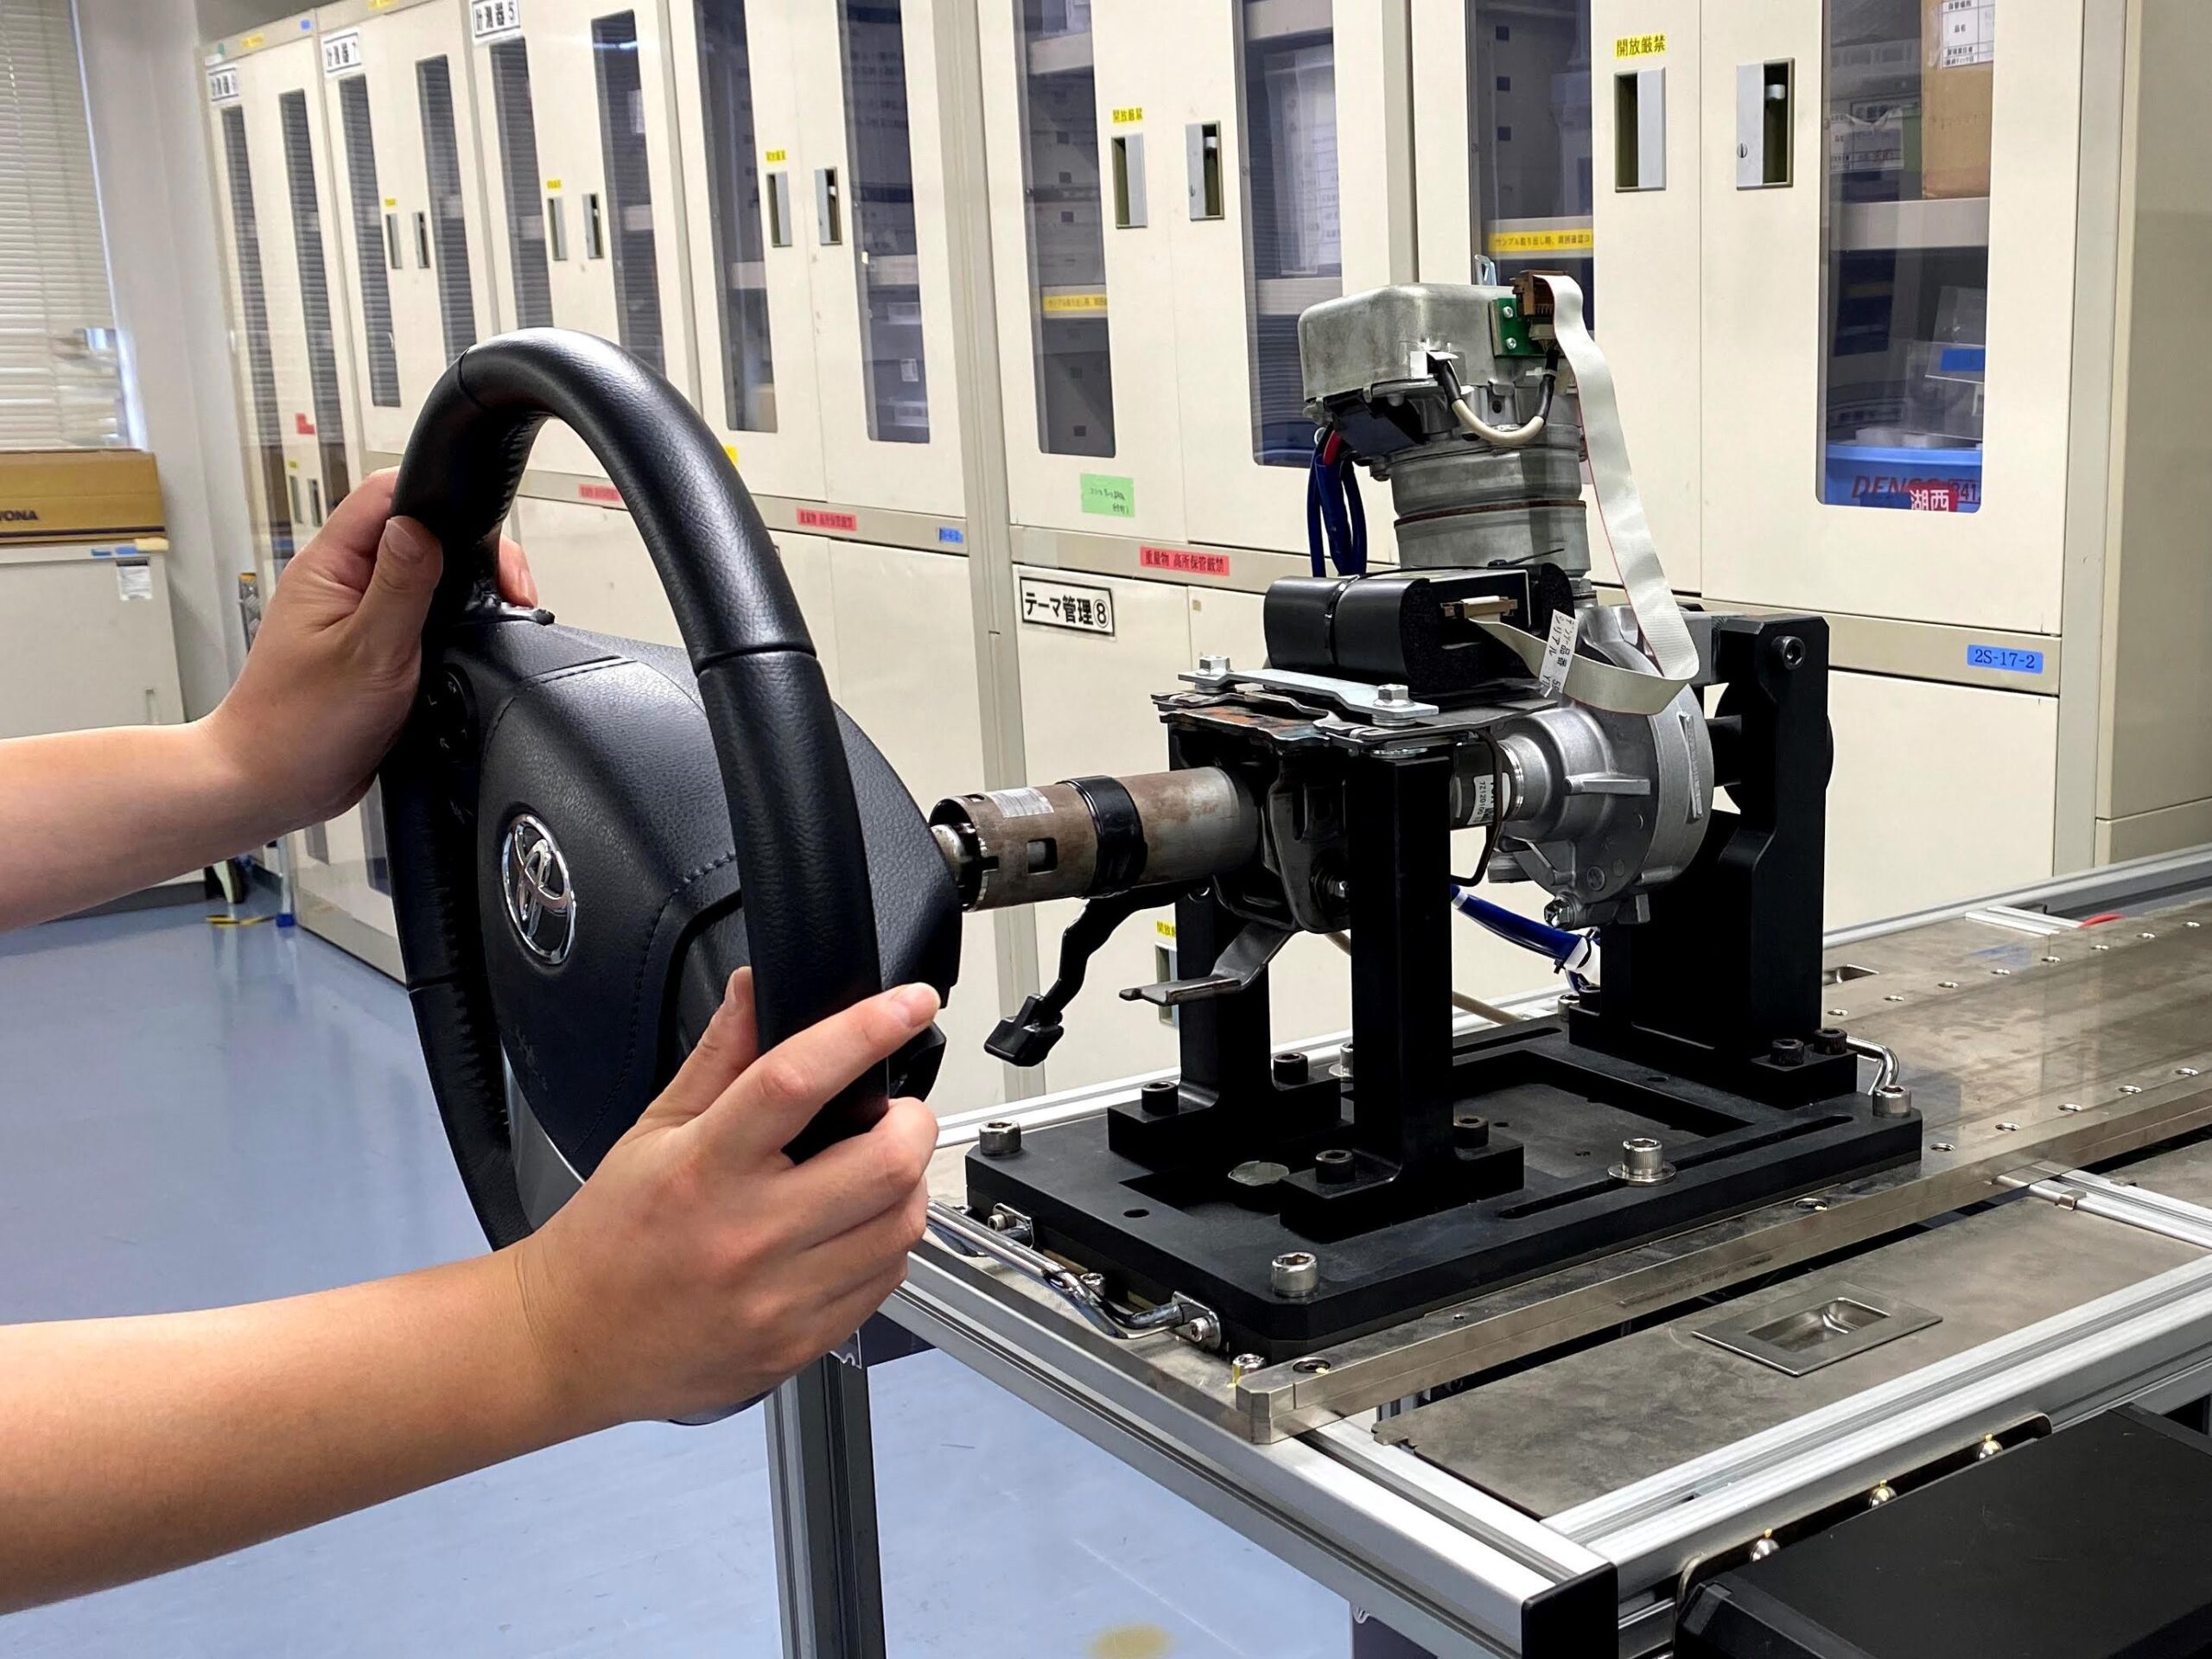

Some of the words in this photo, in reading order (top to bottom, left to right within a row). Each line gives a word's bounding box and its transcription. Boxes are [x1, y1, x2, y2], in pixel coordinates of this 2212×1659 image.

[1617, 35, 1665, 57] 開放厳禁
[1910, 489, 1949, 512] 湖西
[1974, 648, 2035, 670] 2S-17-2
